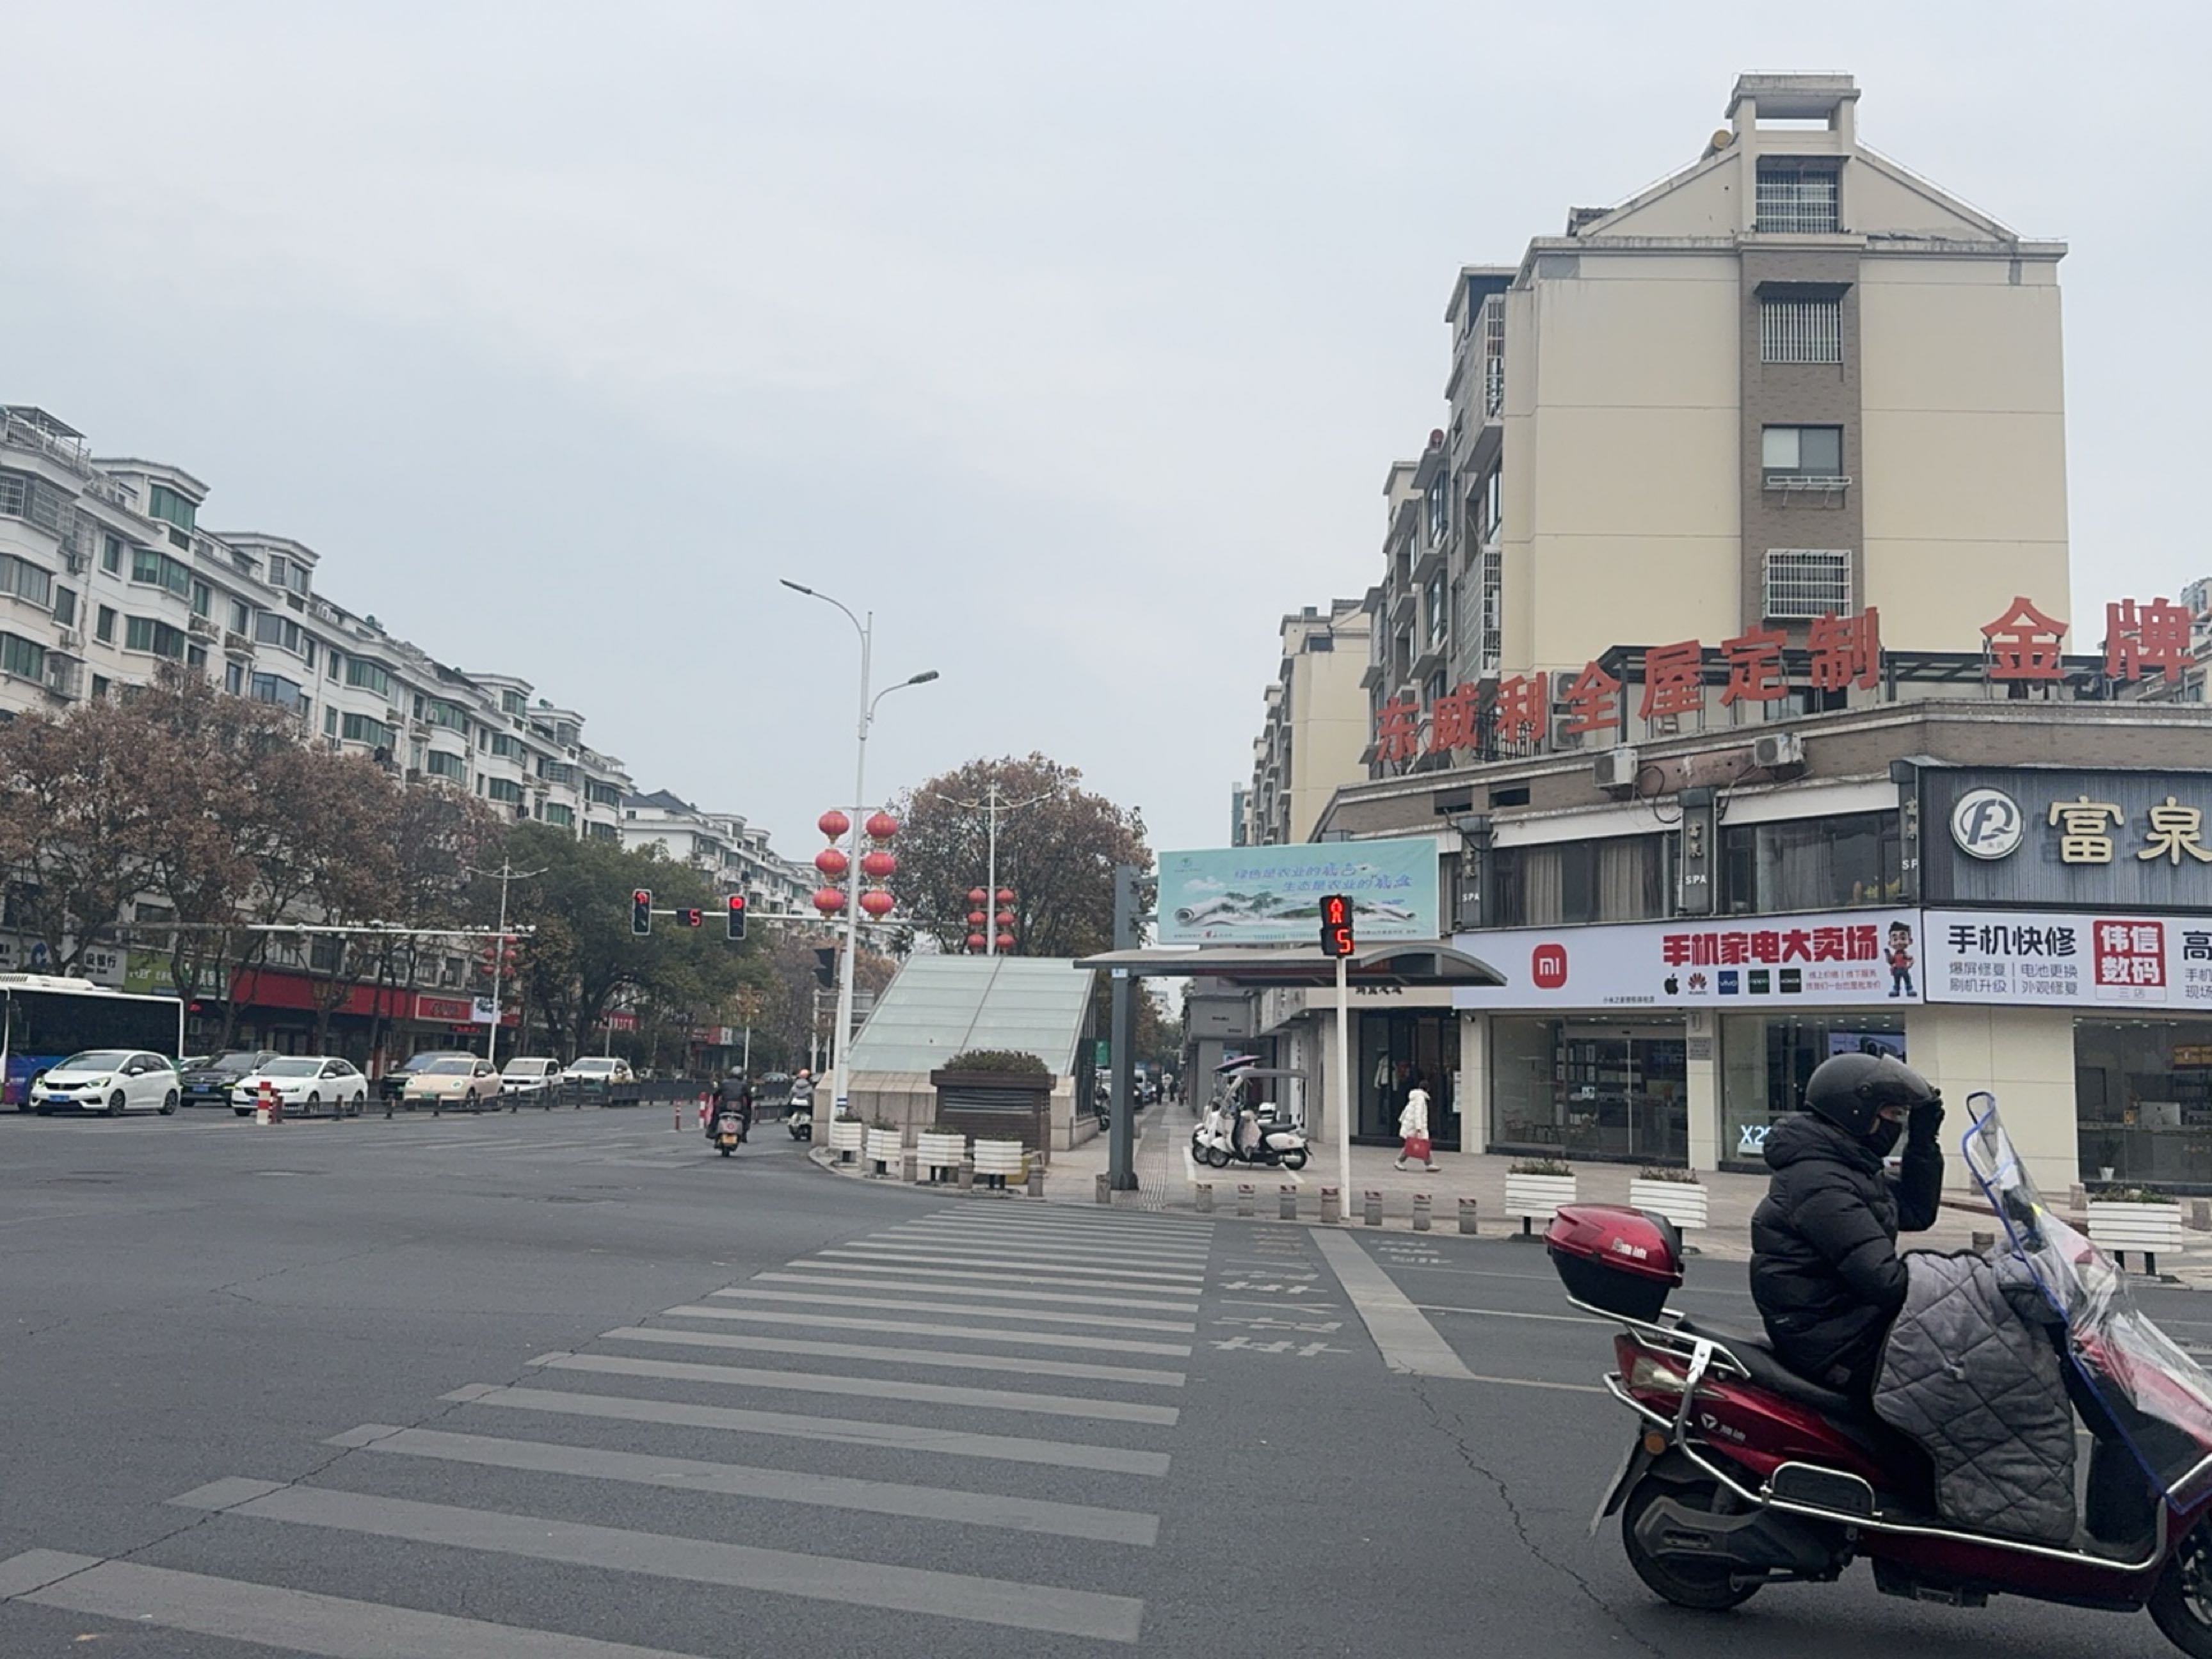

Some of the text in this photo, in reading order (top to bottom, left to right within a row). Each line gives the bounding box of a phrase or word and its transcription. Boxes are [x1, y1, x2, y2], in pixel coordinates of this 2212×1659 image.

[1981, 596, 2195, 682] 金牌
[2048, 796, 2212, 865] 富泉
[1902, 858, 1918, 870] SP
[1685, 875, 1707, 886] SPA
[1462, 892, 1480, 903] SPA
[689, 909, 701, 926] 5
[1337, 928, 1352, 954] 5
[1663, 925, 1879, 966] 手机家电大卖场
[1948, 925, 2077, 957] 手机快修
[2100, 926, 2160, 953] 伟信
[2021, 963, 2078, 979] 电池更换
[2101, 956, 2161, 984] 数码
[2021, 980, 2079, 996] 外观修复
[1740, 1125, 1772, 1144] X2
